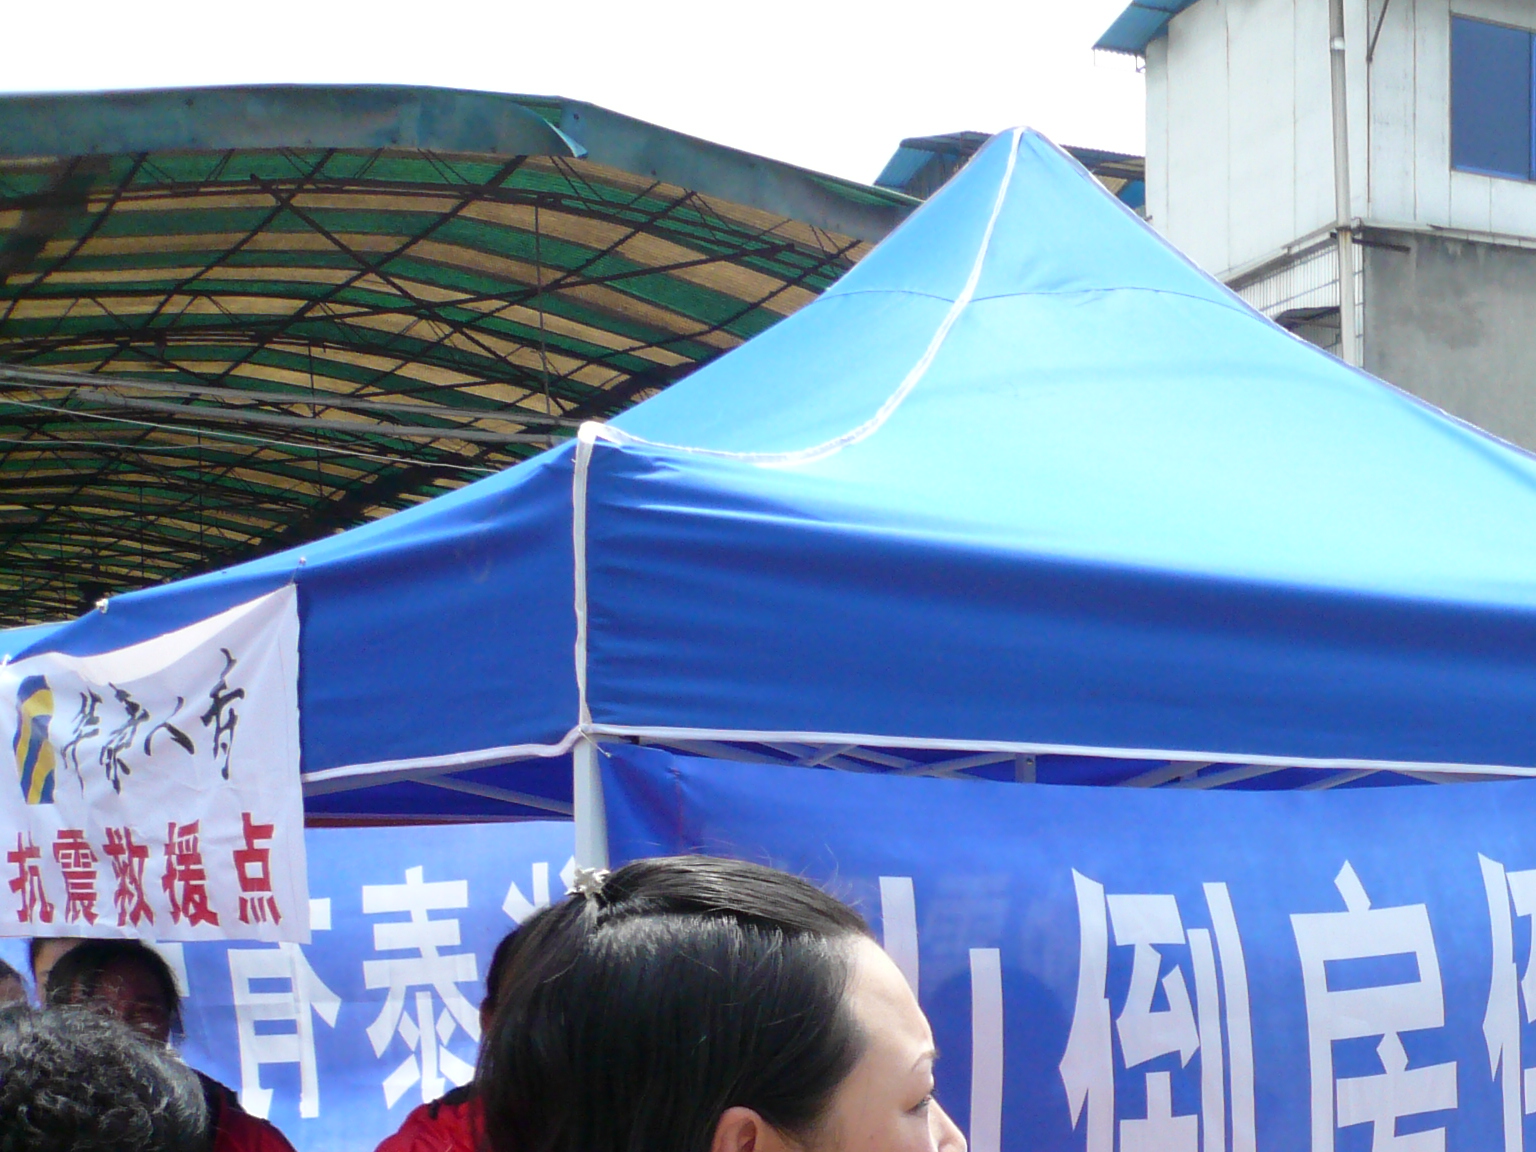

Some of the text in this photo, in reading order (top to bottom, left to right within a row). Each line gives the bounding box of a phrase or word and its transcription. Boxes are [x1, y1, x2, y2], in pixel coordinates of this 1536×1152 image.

[7, 812, 282, 928] 抗震救援点
